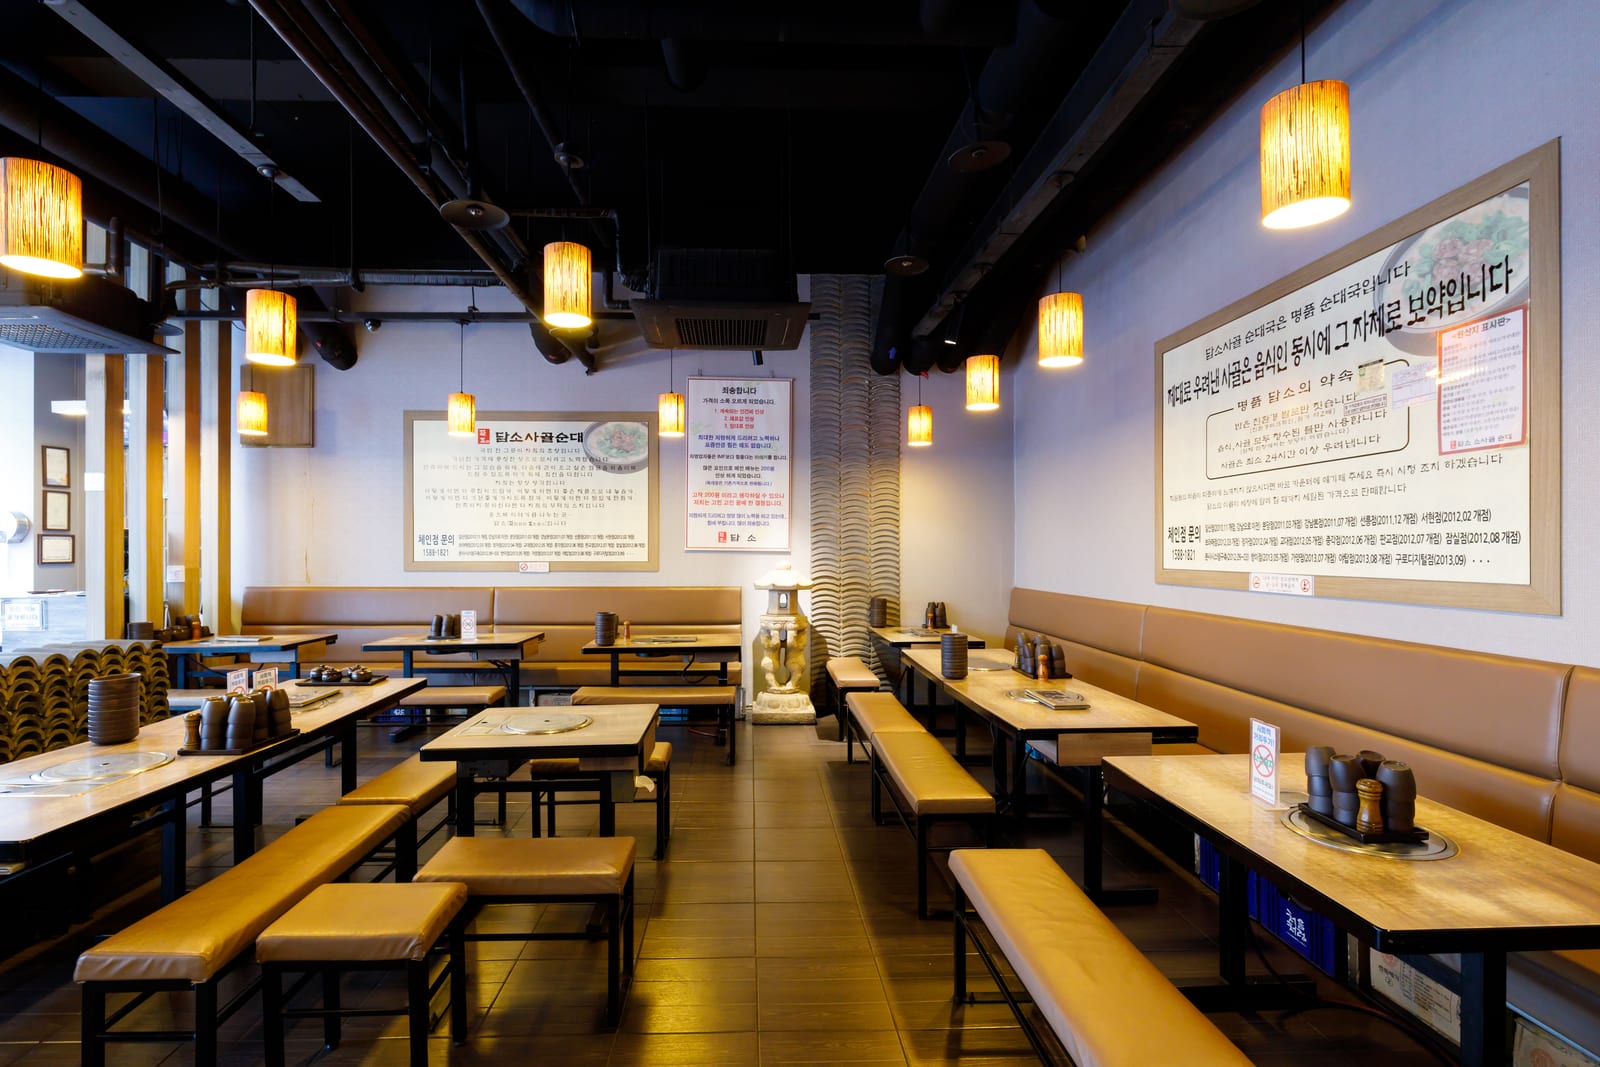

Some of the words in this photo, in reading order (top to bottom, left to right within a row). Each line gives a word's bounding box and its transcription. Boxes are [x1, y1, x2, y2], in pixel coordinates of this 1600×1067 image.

[1206, 334, 1241, 360] 담소사골
[1245, 315, 1287, 344] 순대국은
[1291, 302, 1315, 323] 명품
[1320, 261, 1411, 312] 순대국입니다
[1167, 381, 1191, 407] 제대로
[1193, 368, 1220, 400] 우려낸
[1221, 356, 1252, 388] 사골은
[1254, 341, 1287, 380] 음식인
[1291, 324, 1331, 367] 동시에
[1335, 321, 1349, 350] 그
[1353, 300, 1403, 342] 자체로
[1407, 254, 1513, 327] 보약입니다
[721, 386, 757, 395] 죄송합니다
[1238, 395, 1262, 412] 명품
[1268, 380, 1311, 404] 담소의
[1320, 369, 1354, 387] 약속
[1328, 409, 1387, 428] 사용합니다
[496, 431, 584, 443] 담소사골순대
[1265, 449, 1296, 463] 24시간
[1300, 445, 1319, 456] 이상
[1323, 434, 1381, 452] 우려냅니다
[1397, 464, 1416, 475] 시정
[1420, 461, 1440, 473] 조치
[1444, 453, 1503, 470] 하겠습니다
[418, 534, 439, 546] 체인점
[440, 534, 455, 546] 문의
[1168, 525, 1187, 543] 체인점
[1188, 525, 1201, 543] 문의
[423, 548, 449, 557] 1588-1821
[1172, 548, 1195, 561] 1588-1821
[1395, 553, 1466, 567] 구로디지털점(2013.09)
